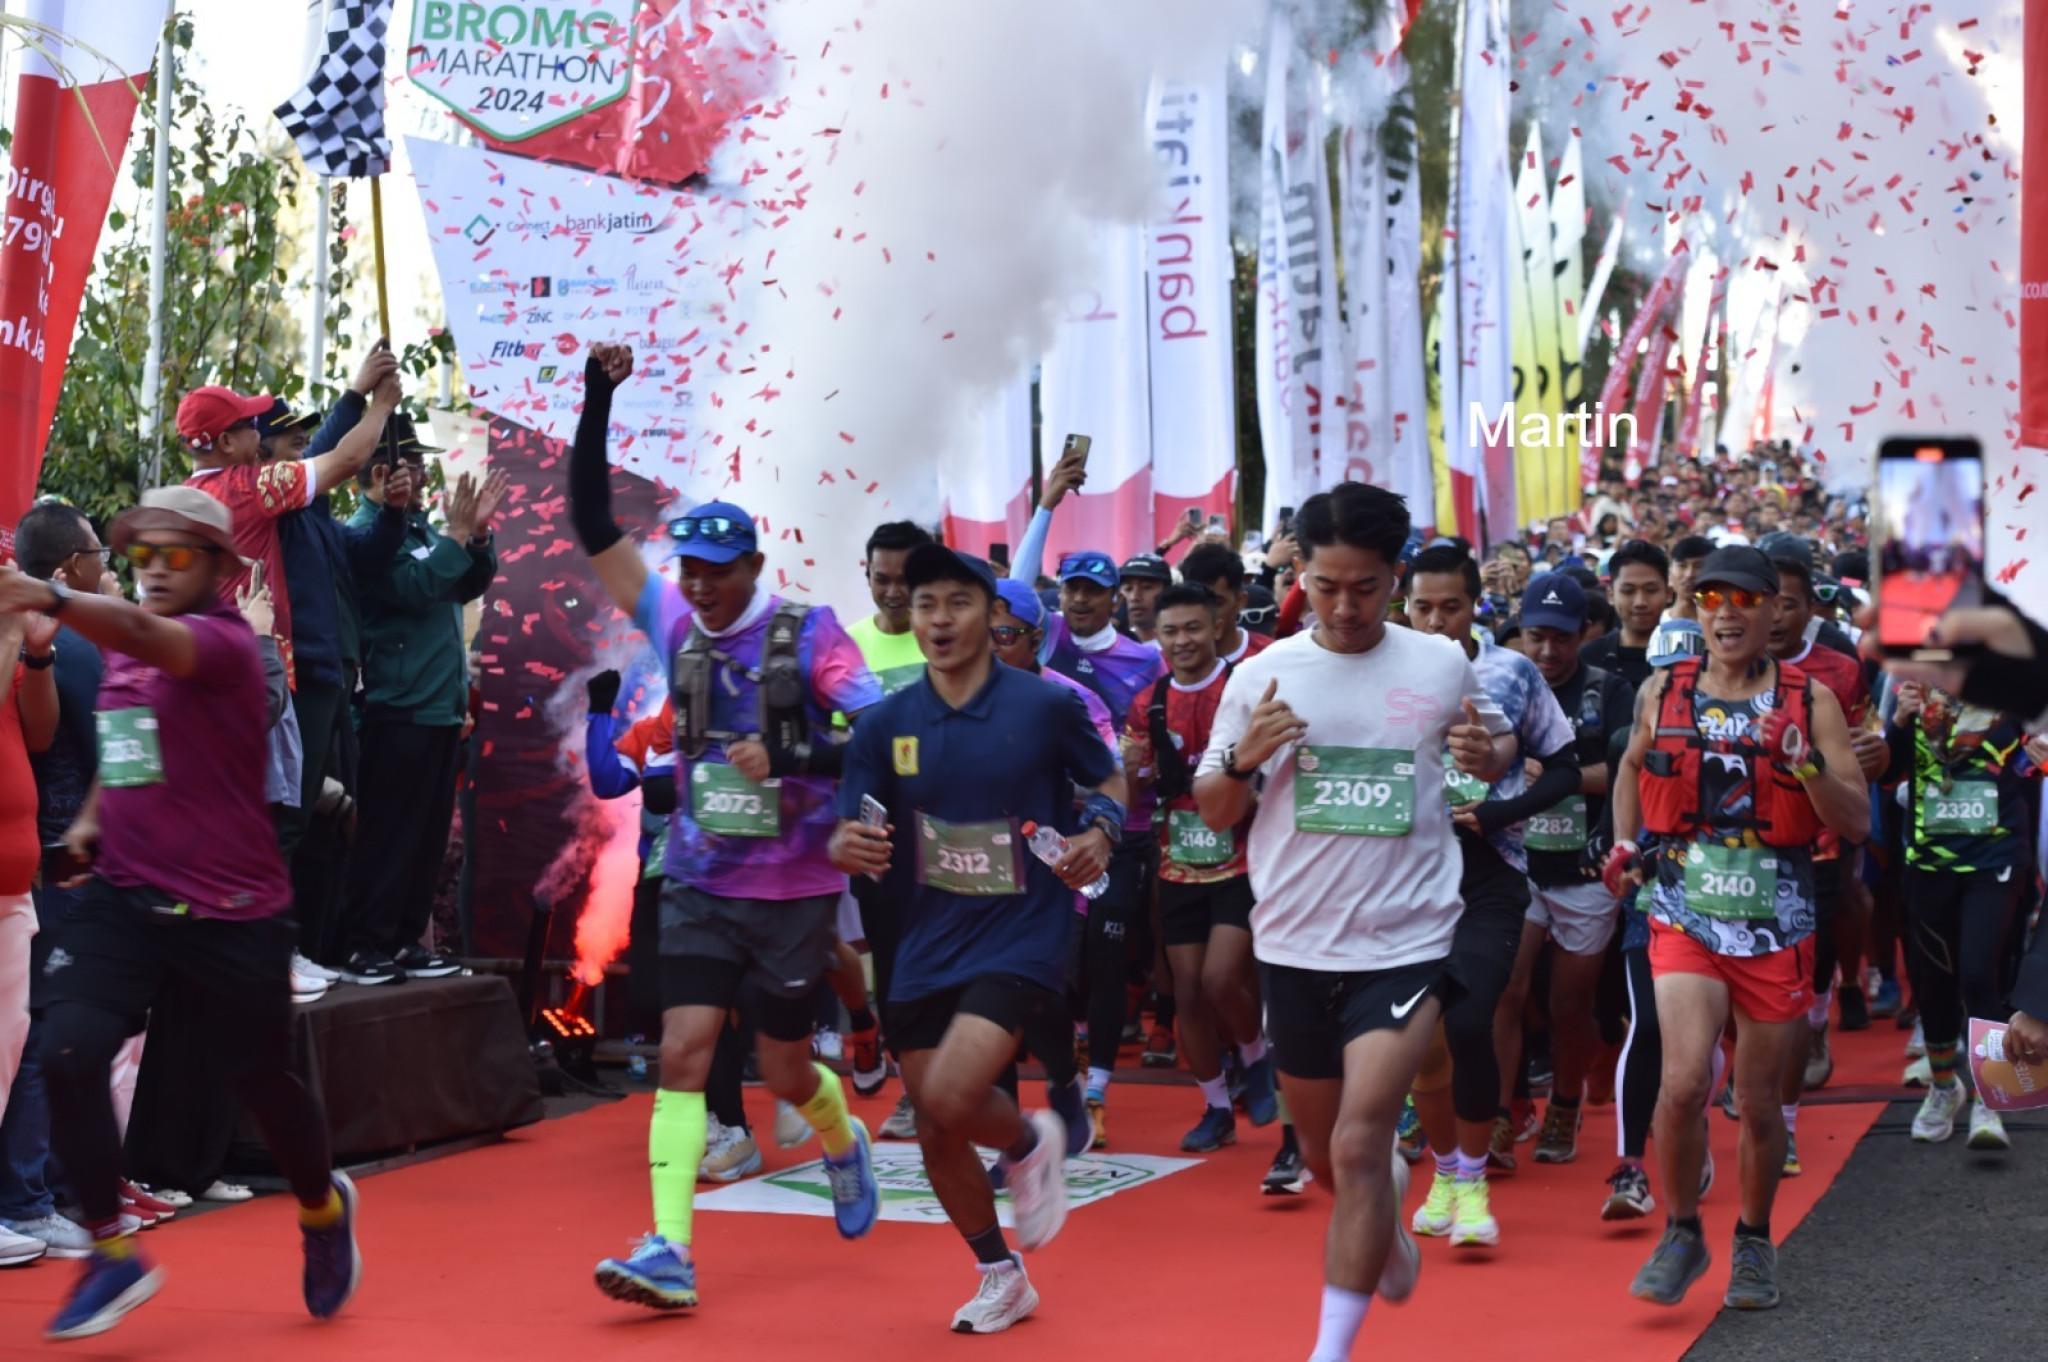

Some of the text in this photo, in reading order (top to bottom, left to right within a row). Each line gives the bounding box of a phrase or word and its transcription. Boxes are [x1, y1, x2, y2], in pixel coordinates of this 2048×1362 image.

[422, 2, 619, 50] BROMO
[421, 48, 616, 85] MARATHON
[477, 87, 545, 114] 2024
[702, 791, 762, 815] 2073
[1314, 780, 1392, 808] 2309
[1936, 802, 1985, 819] 2320
[1529, 816, 1574, 834] 2282
[1179, 831, 1217, 848] 2146
[937, 849, 992, 874] 2312
[1701, 872, 1756, 897] 2140
